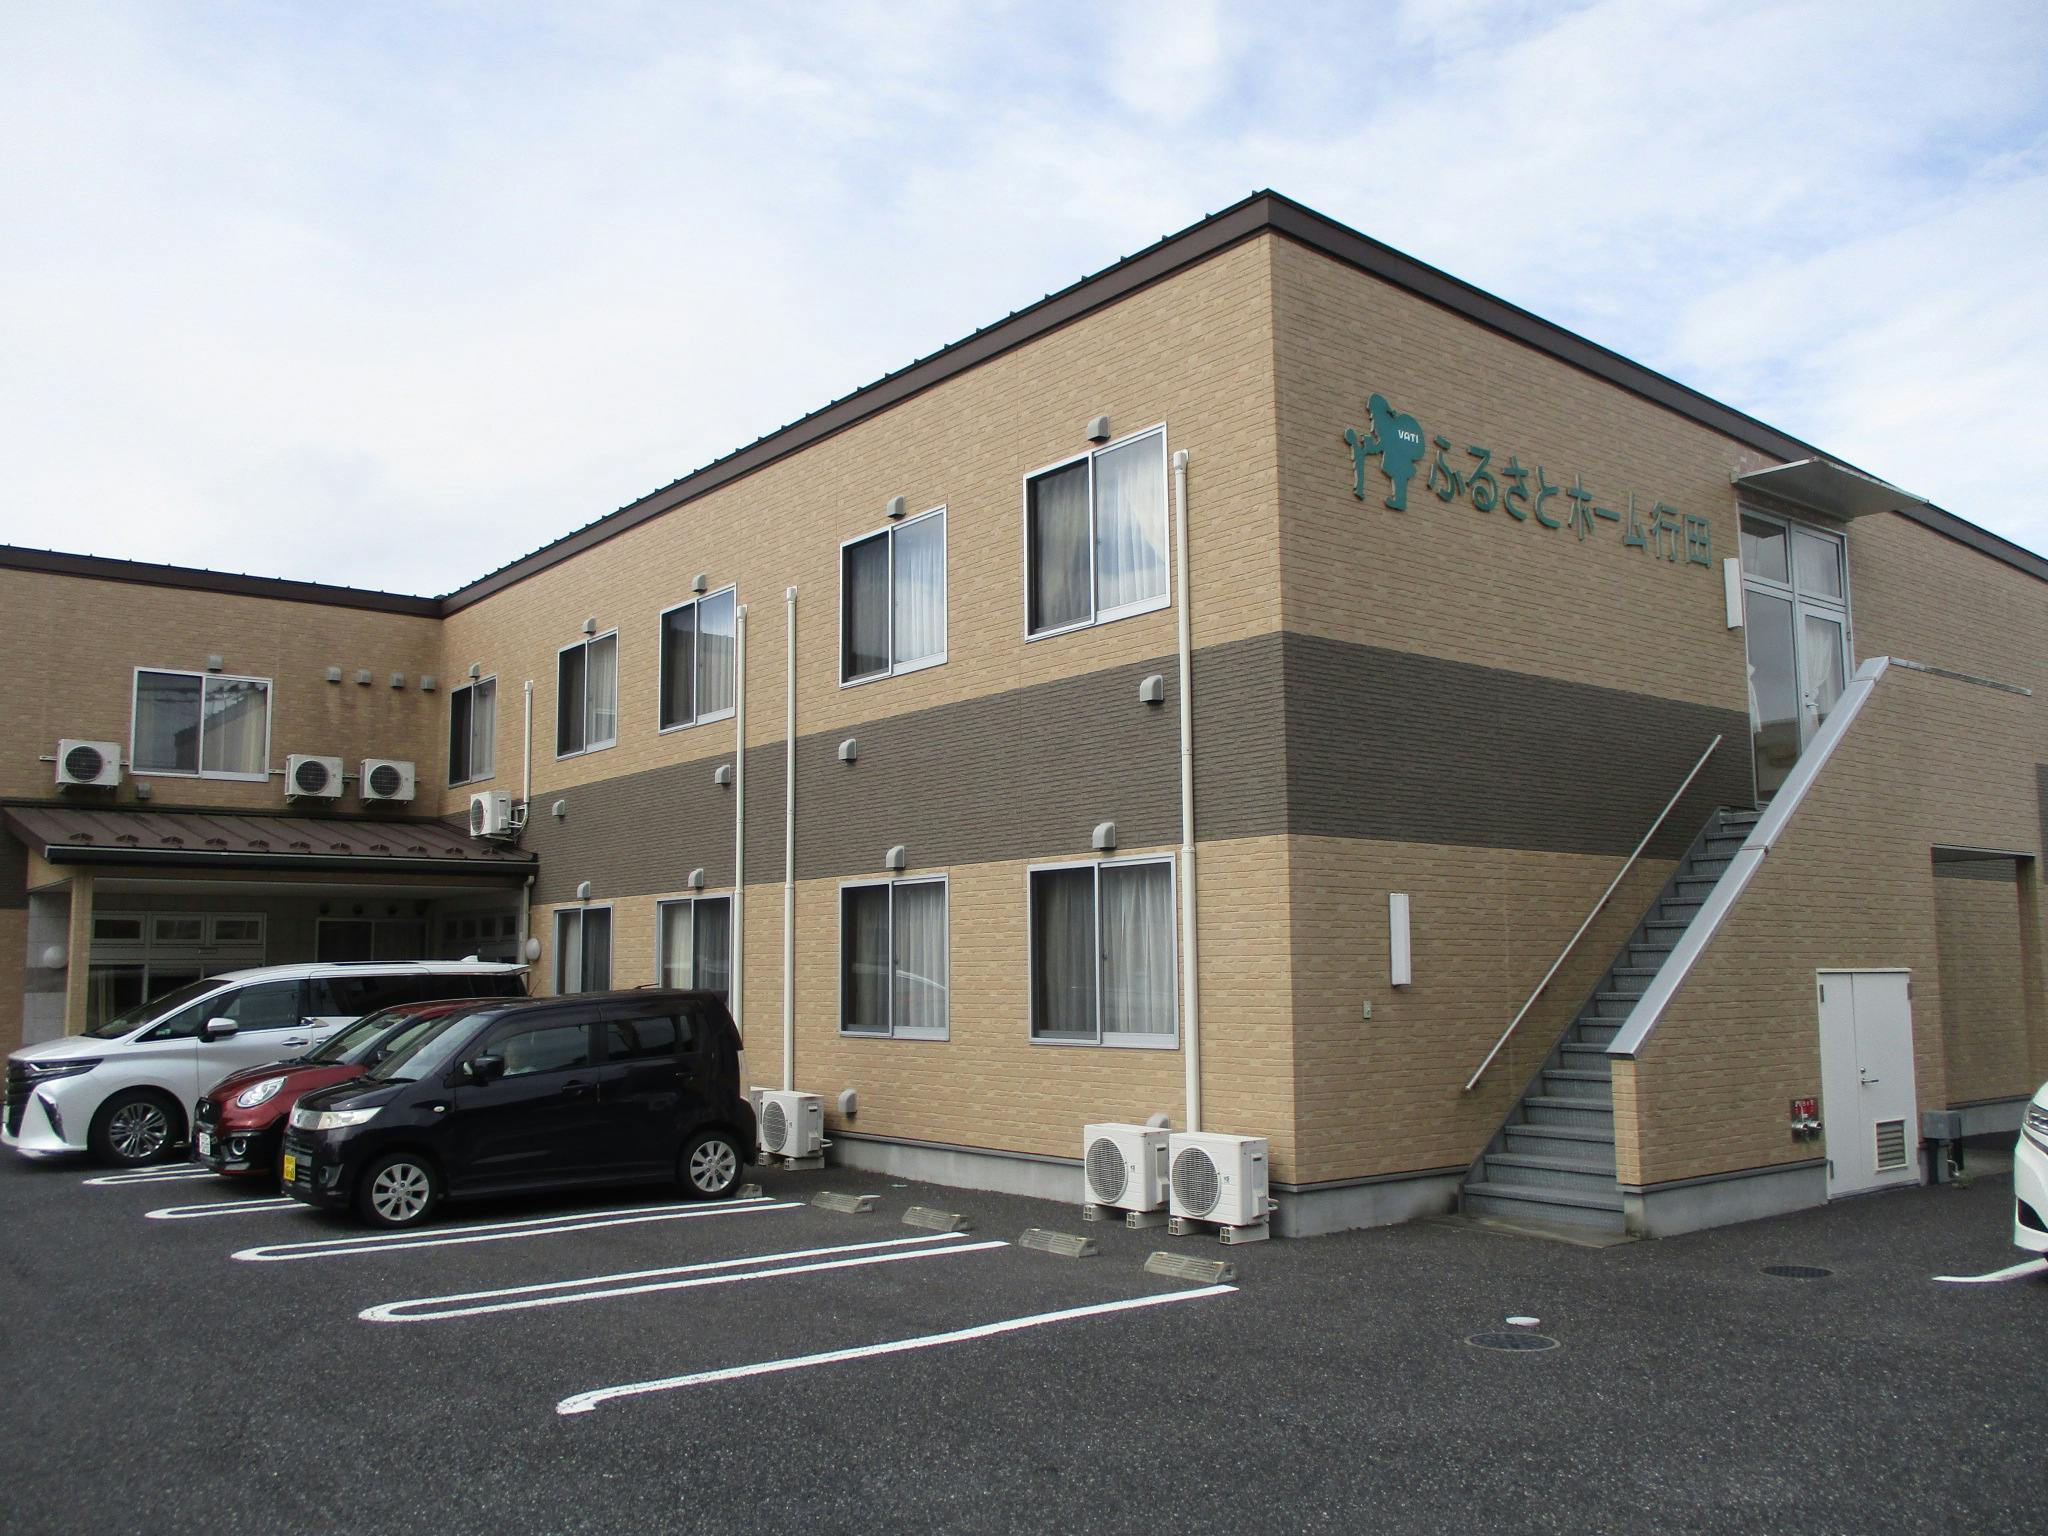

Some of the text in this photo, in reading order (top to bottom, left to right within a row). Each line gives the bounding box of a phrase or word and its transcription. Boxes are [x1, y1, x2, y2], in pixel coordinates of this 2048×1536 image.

[1398, 429, 1419, 444] VATI
[1427, 434, 1712, 568] ふるさとホーム行田
